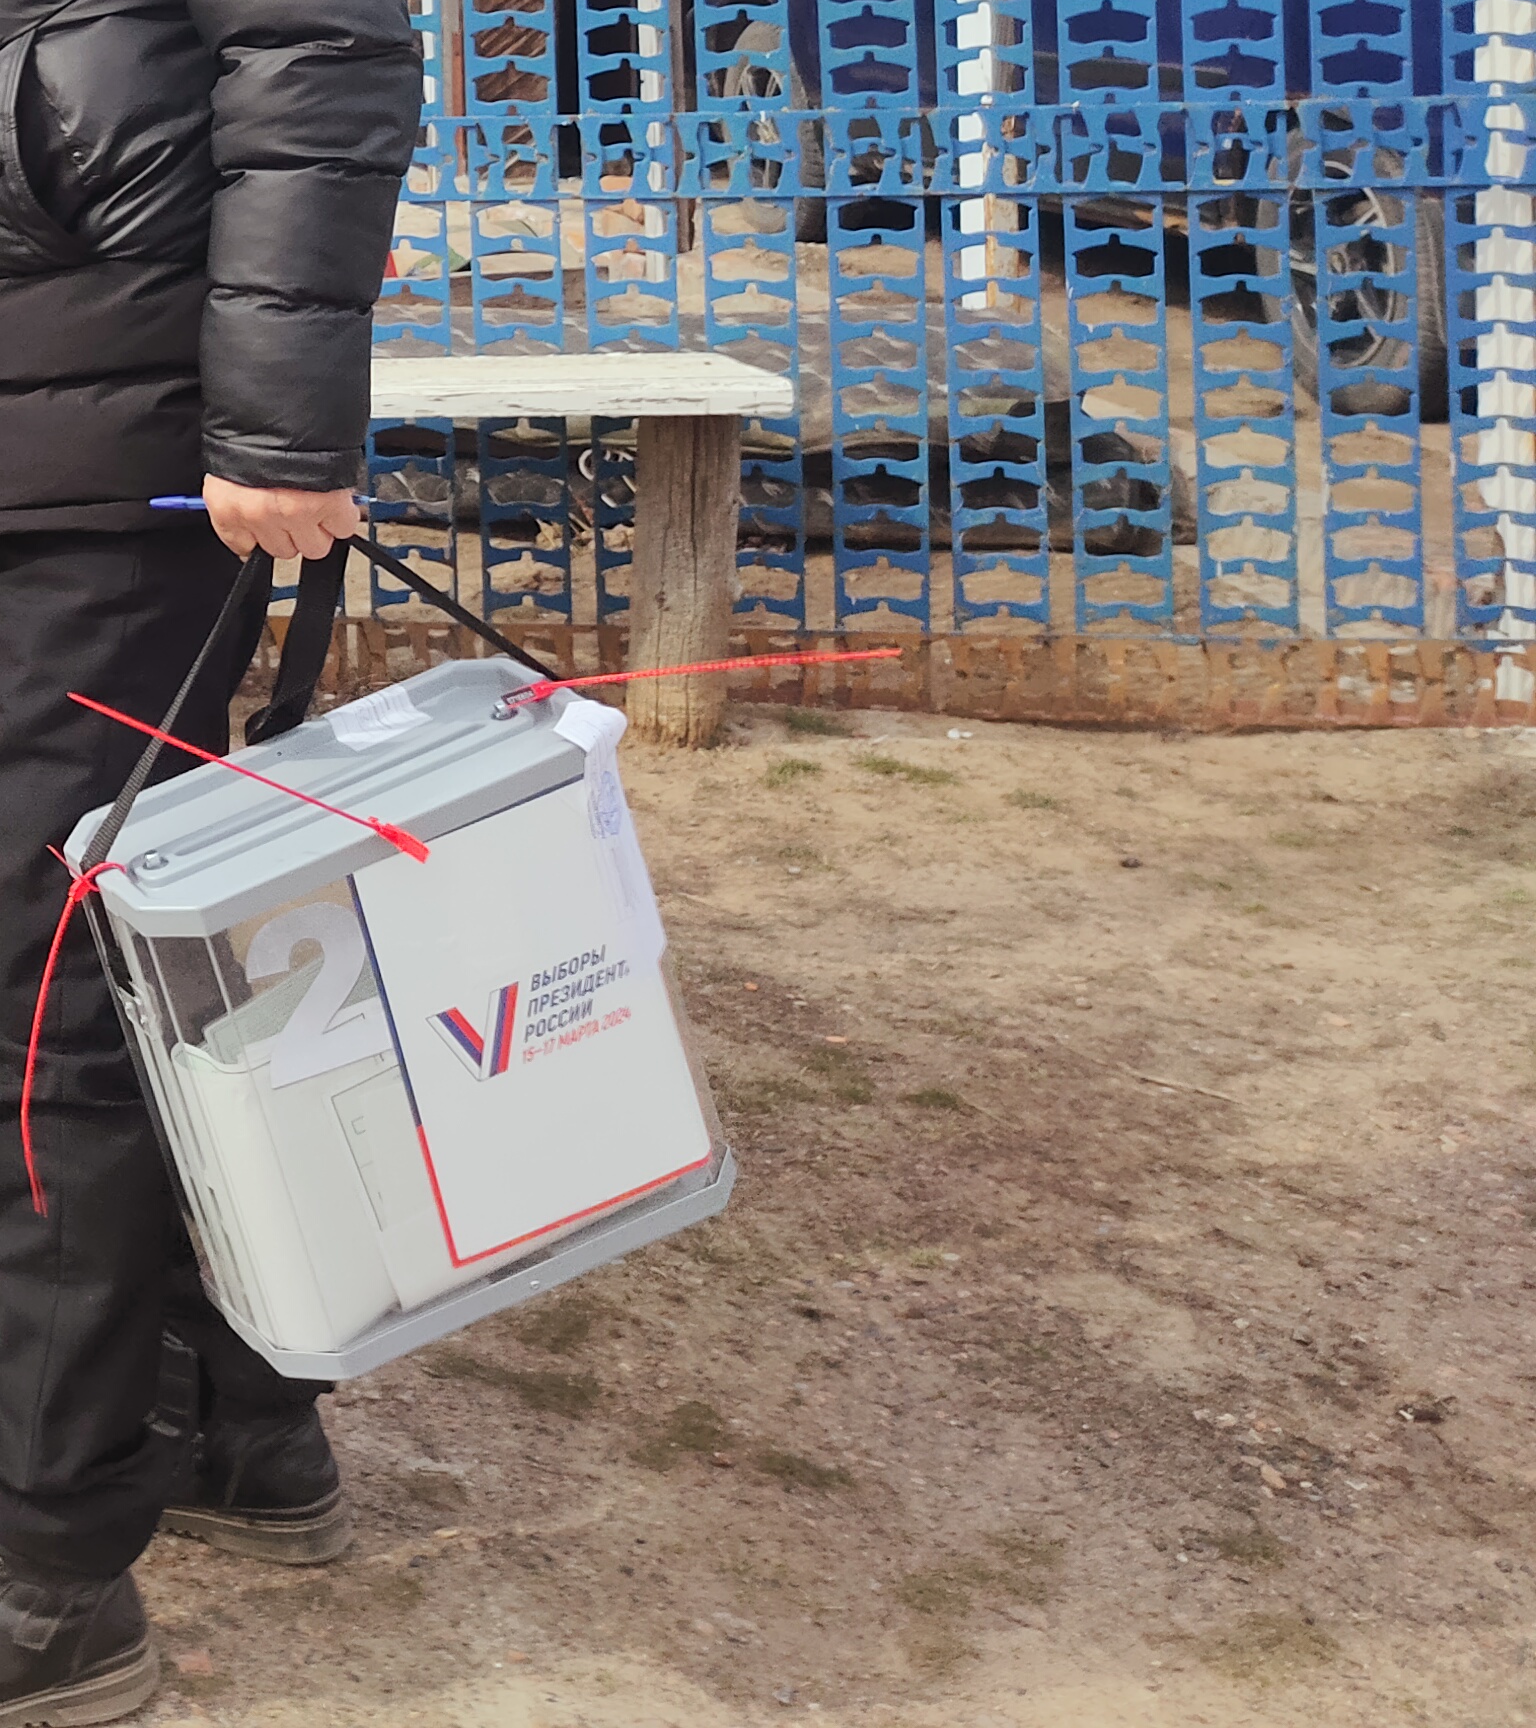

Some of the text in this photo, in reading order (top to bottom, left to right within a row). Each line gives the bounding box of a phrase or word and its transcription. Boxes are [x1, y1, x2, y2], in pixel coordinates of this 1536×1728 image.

[530, 944, 606, 992] ВЫБОРЫ
[245, 901, 395, 1090] 2
[524, 998, 594, 1044] РОССИИ
[557, 1018, 600, 1049] МАРТА
